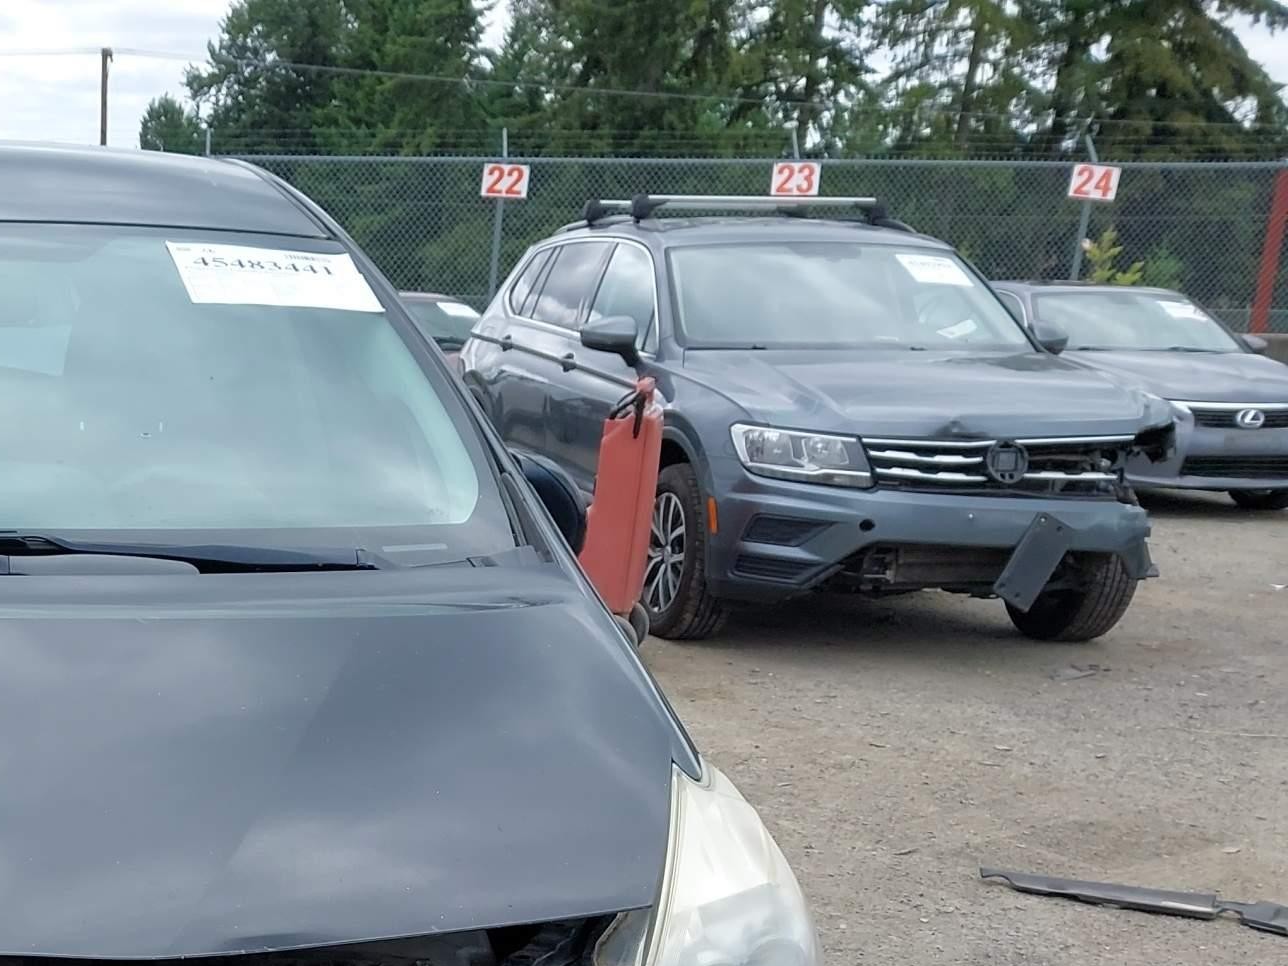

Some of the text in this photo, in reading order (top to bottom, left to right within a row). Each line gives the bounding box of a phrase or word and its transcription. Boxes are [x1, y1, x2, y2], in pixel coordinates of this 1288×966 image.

[487, 165, 524, 195] 22
[776, 164, 815, 193] 23
[1073, 166, 1113, 197] 24
[193, 256, 333, 276] 45483441
